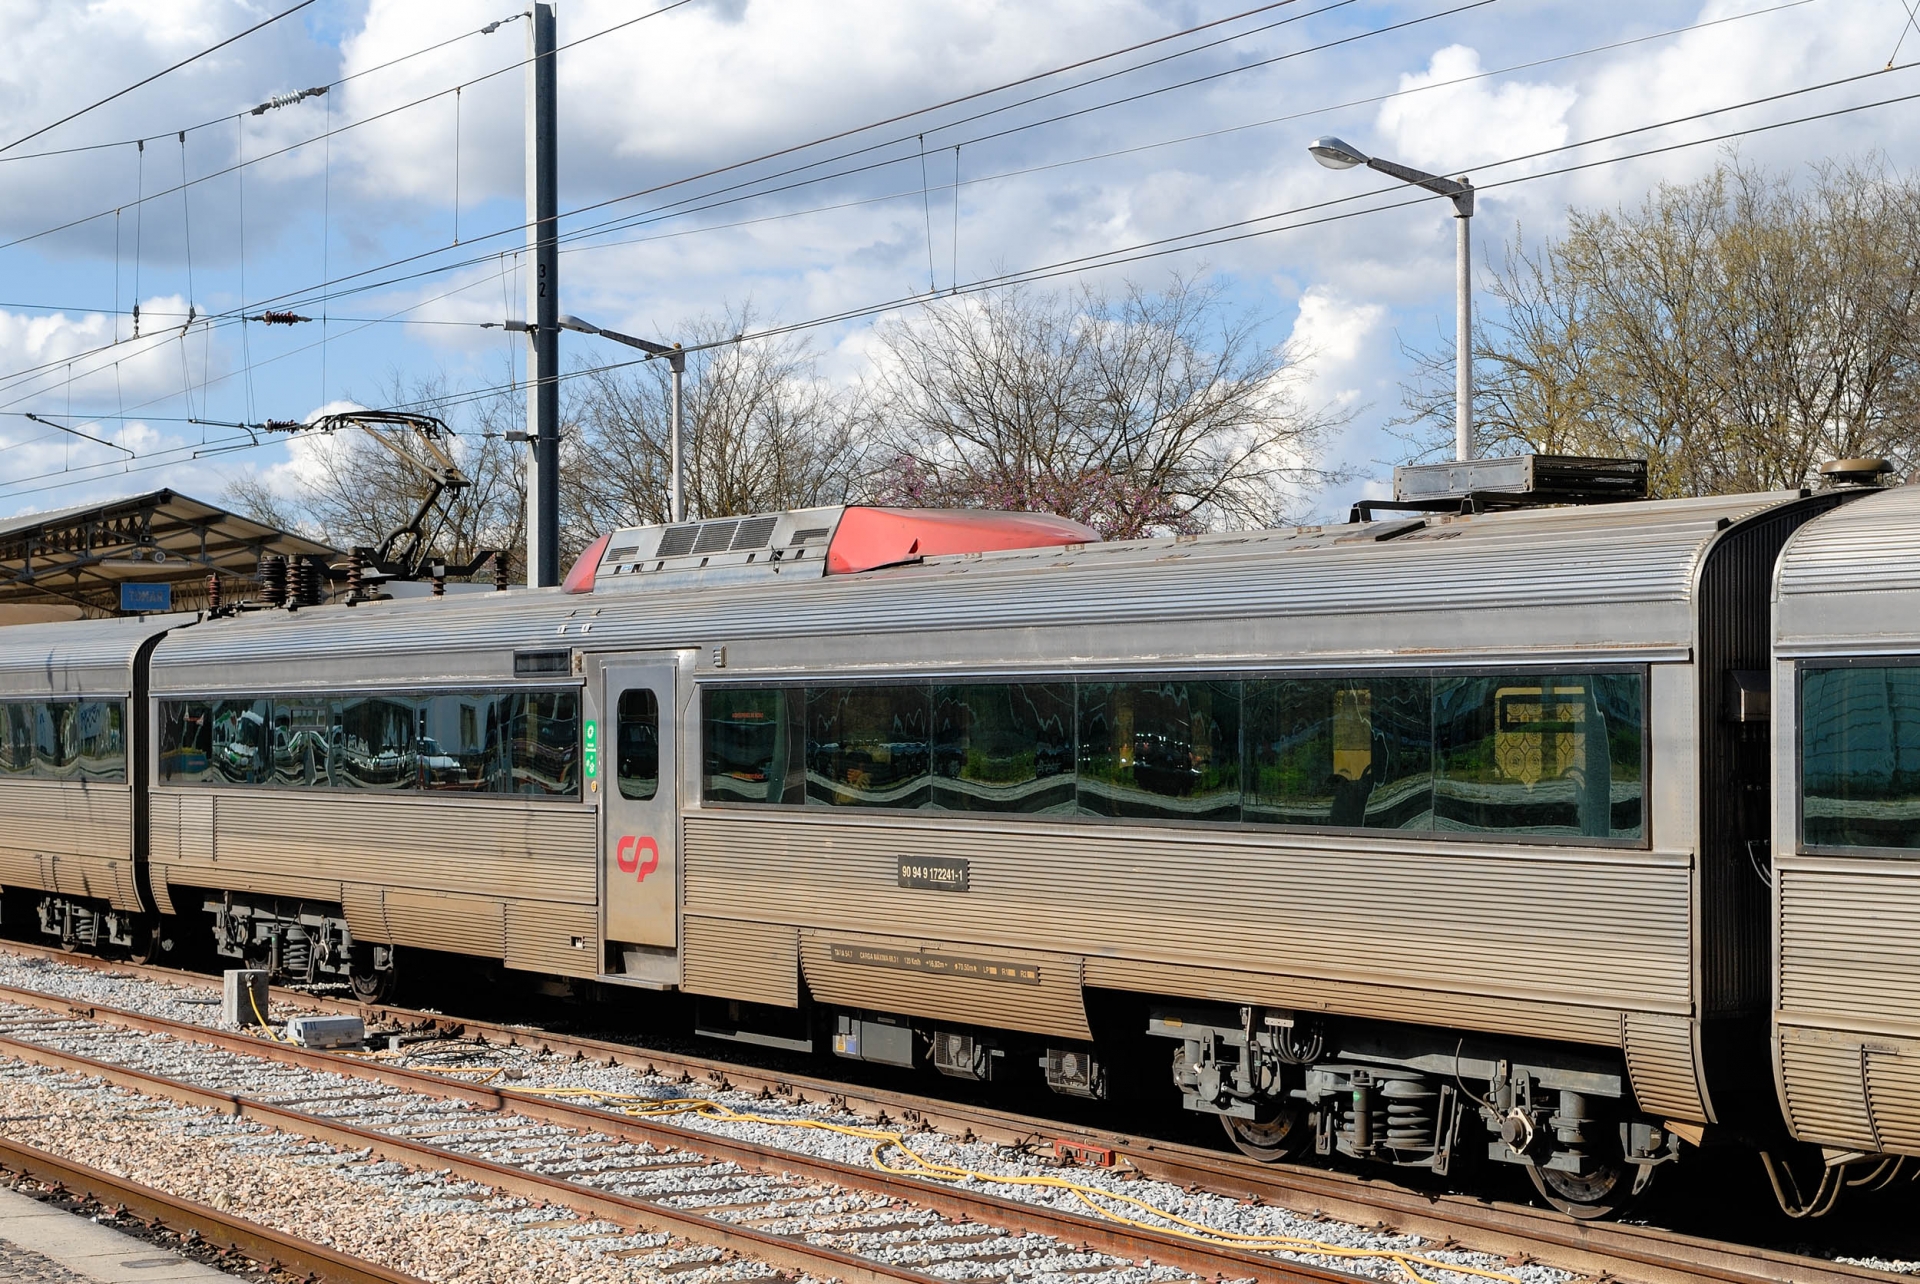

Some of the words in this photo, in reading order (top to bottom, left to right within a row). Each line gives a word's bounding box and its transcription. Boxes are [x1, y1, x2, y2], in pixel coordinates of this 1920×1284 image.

[902, 865, 911, 878] 90
[912, 866, 922, 879] 94
[923, 867, 928, 879] 9
[929, 867, 963, 882] 172241-1
